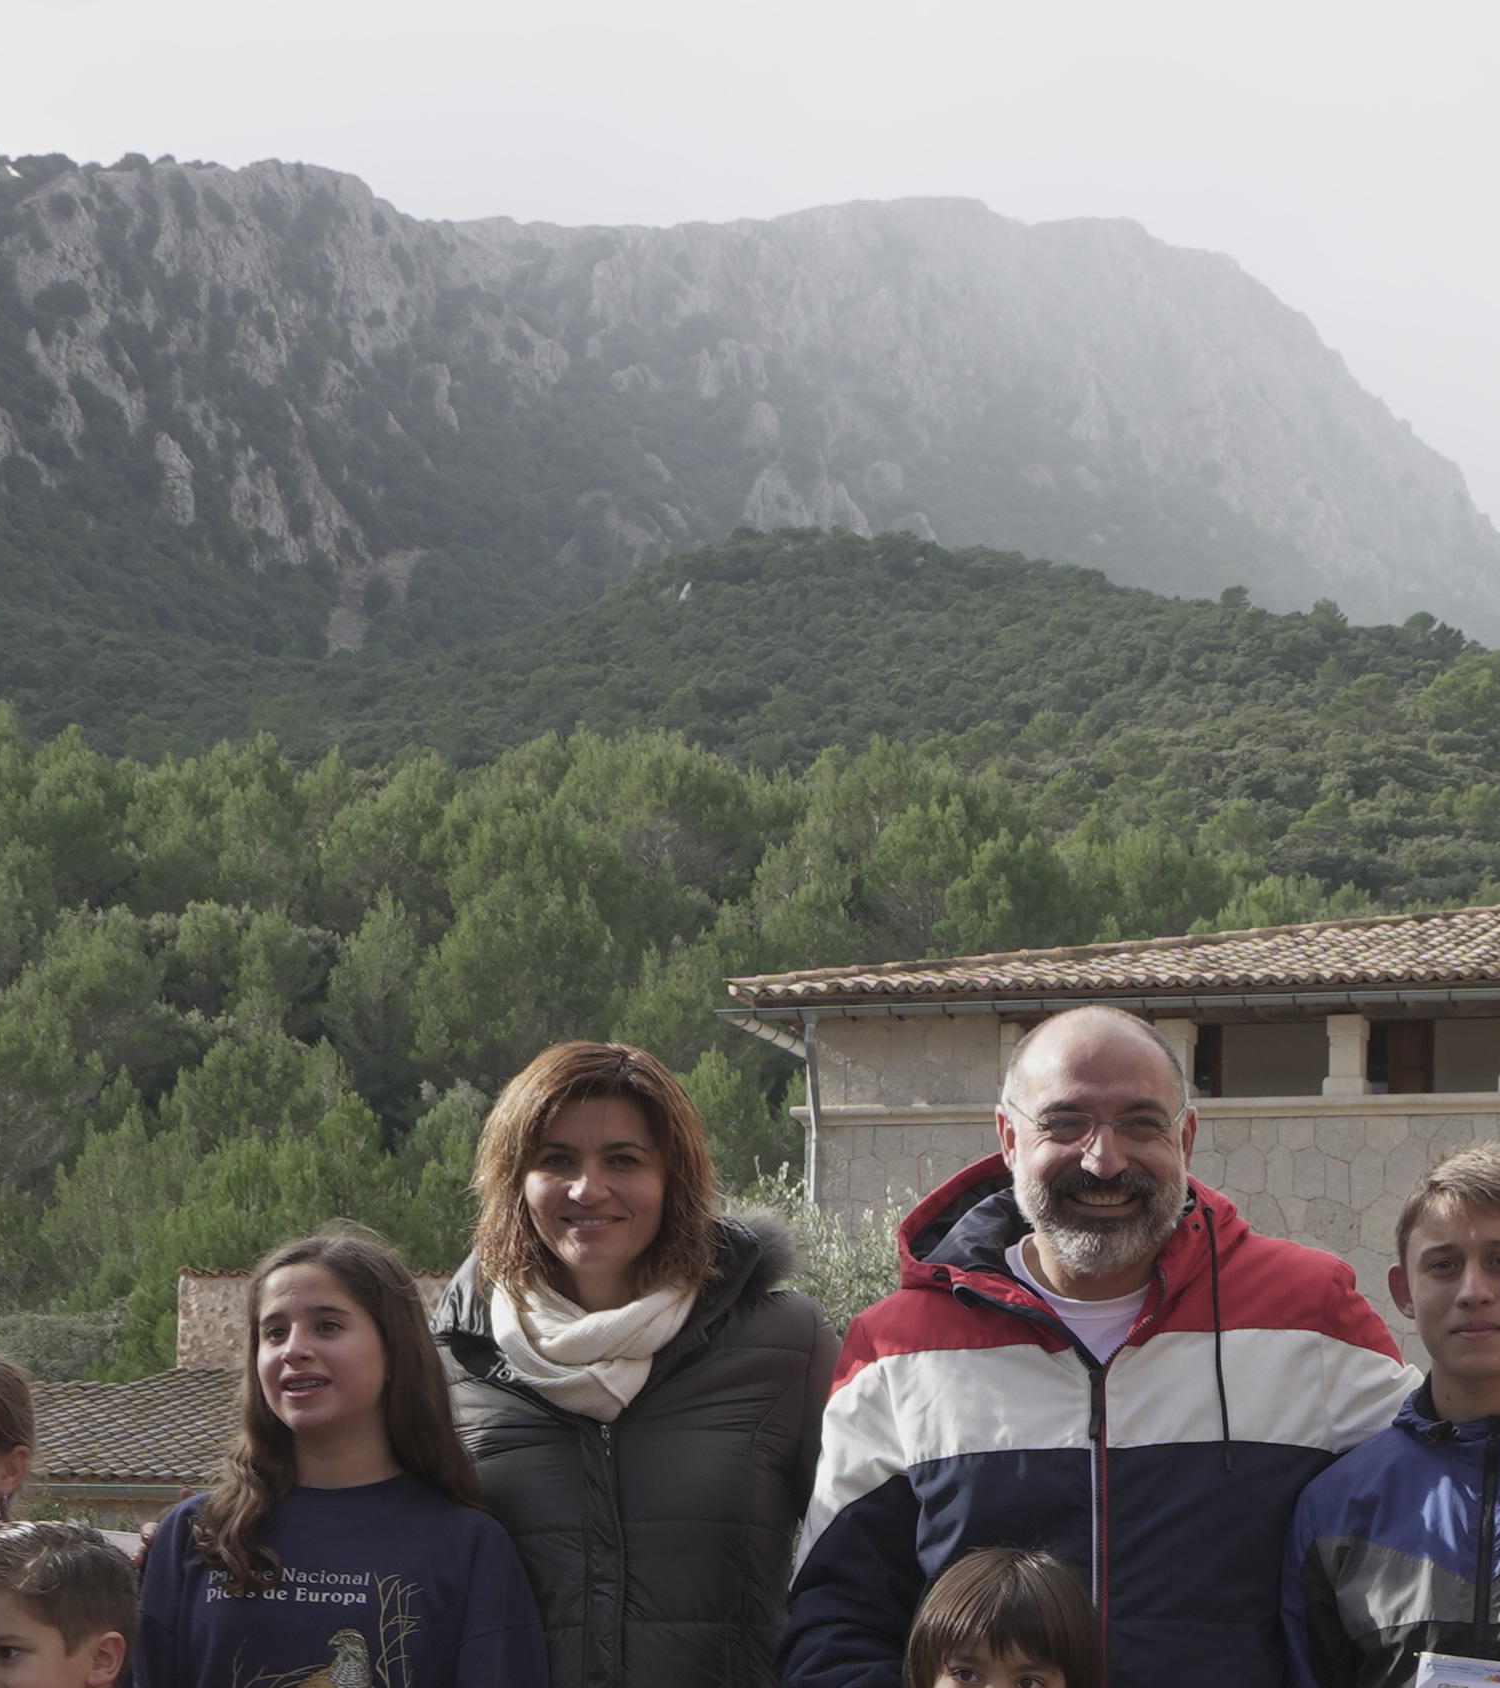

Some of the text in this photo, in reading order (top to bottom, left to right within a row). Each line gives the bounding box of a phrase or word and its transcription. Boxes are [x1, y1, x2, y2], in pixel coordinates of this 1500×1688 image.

[280, 1568, 371, 1586] Nacional
[262, 1587, 288, 1600] de
[295, 1587, 367, 1606] Europa
